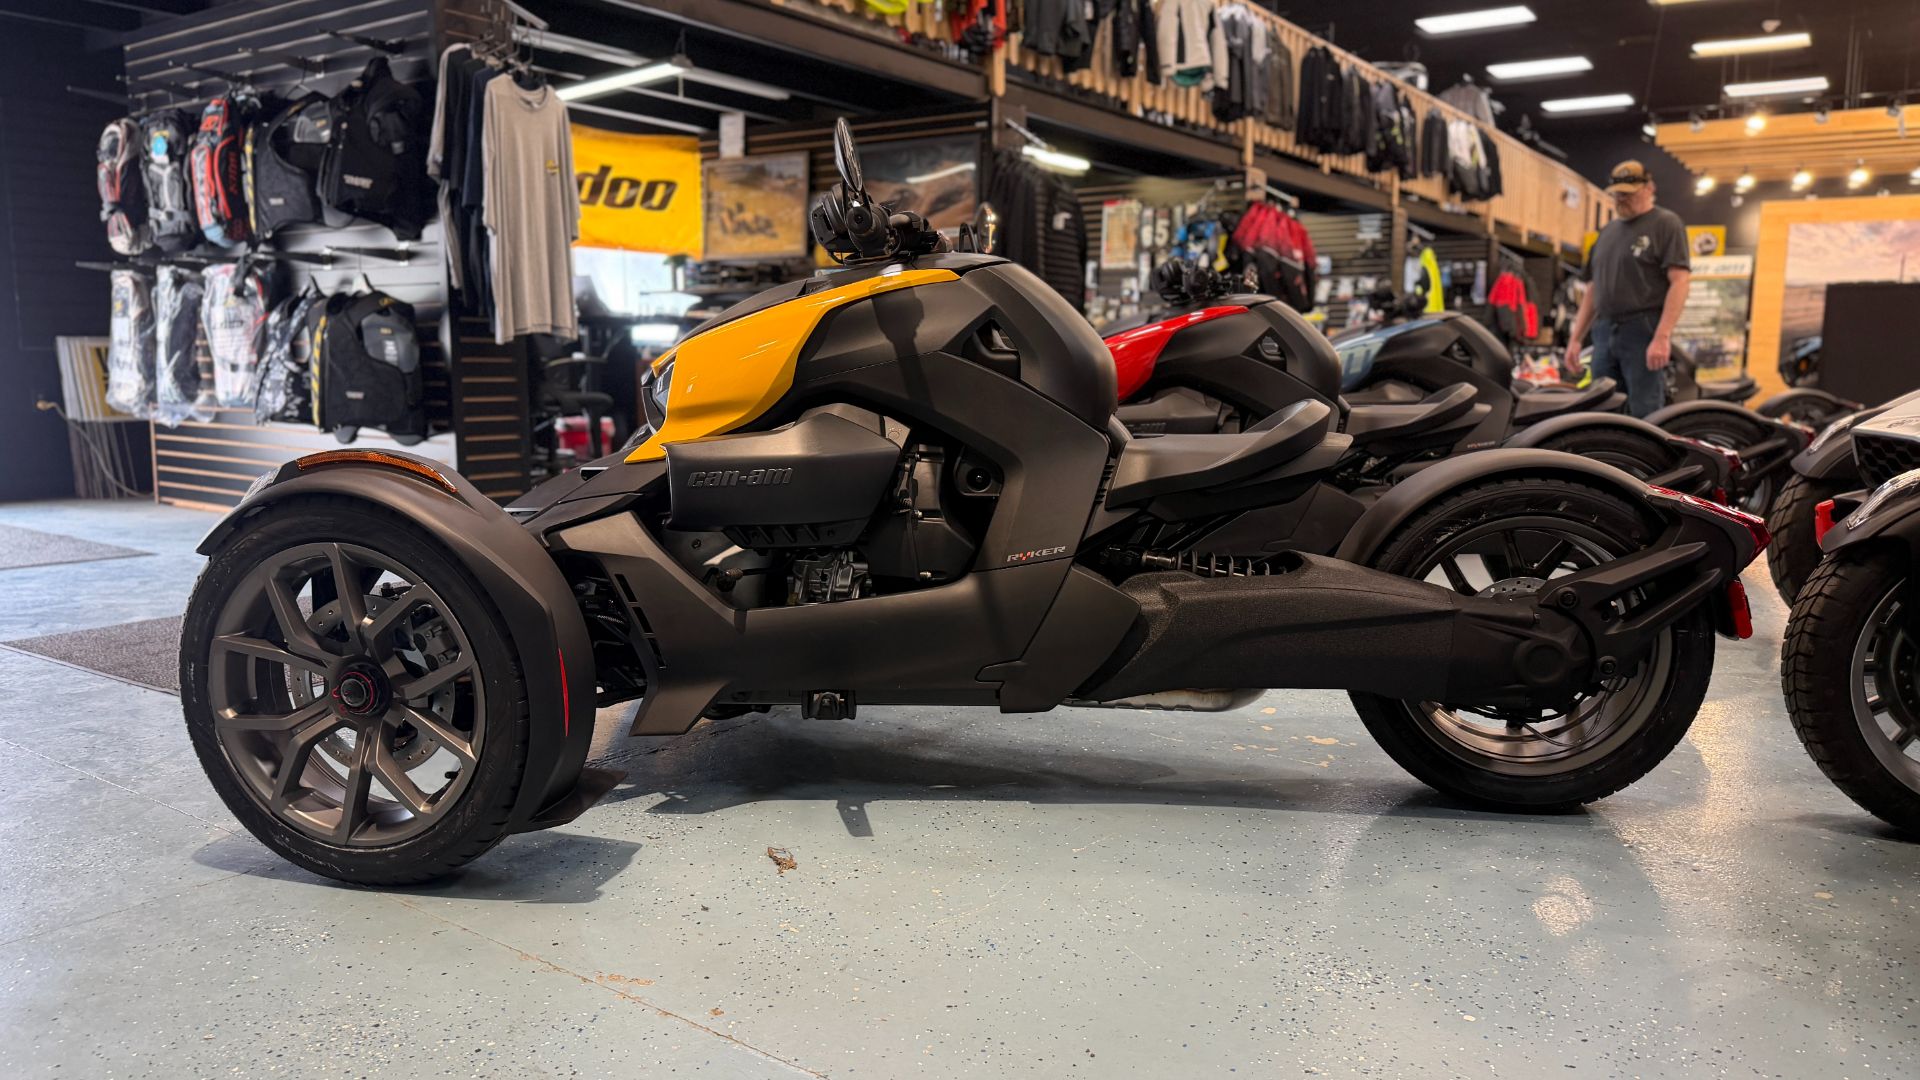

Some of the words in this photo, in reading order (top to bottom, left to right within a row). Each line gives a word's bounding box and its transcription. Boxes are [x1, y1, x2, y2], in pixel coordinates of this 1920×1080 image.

[576, 164, 678, 211] doo
[687, 467, 793, 488] can-am
[1006, 545, 1066, 562] RYKER
